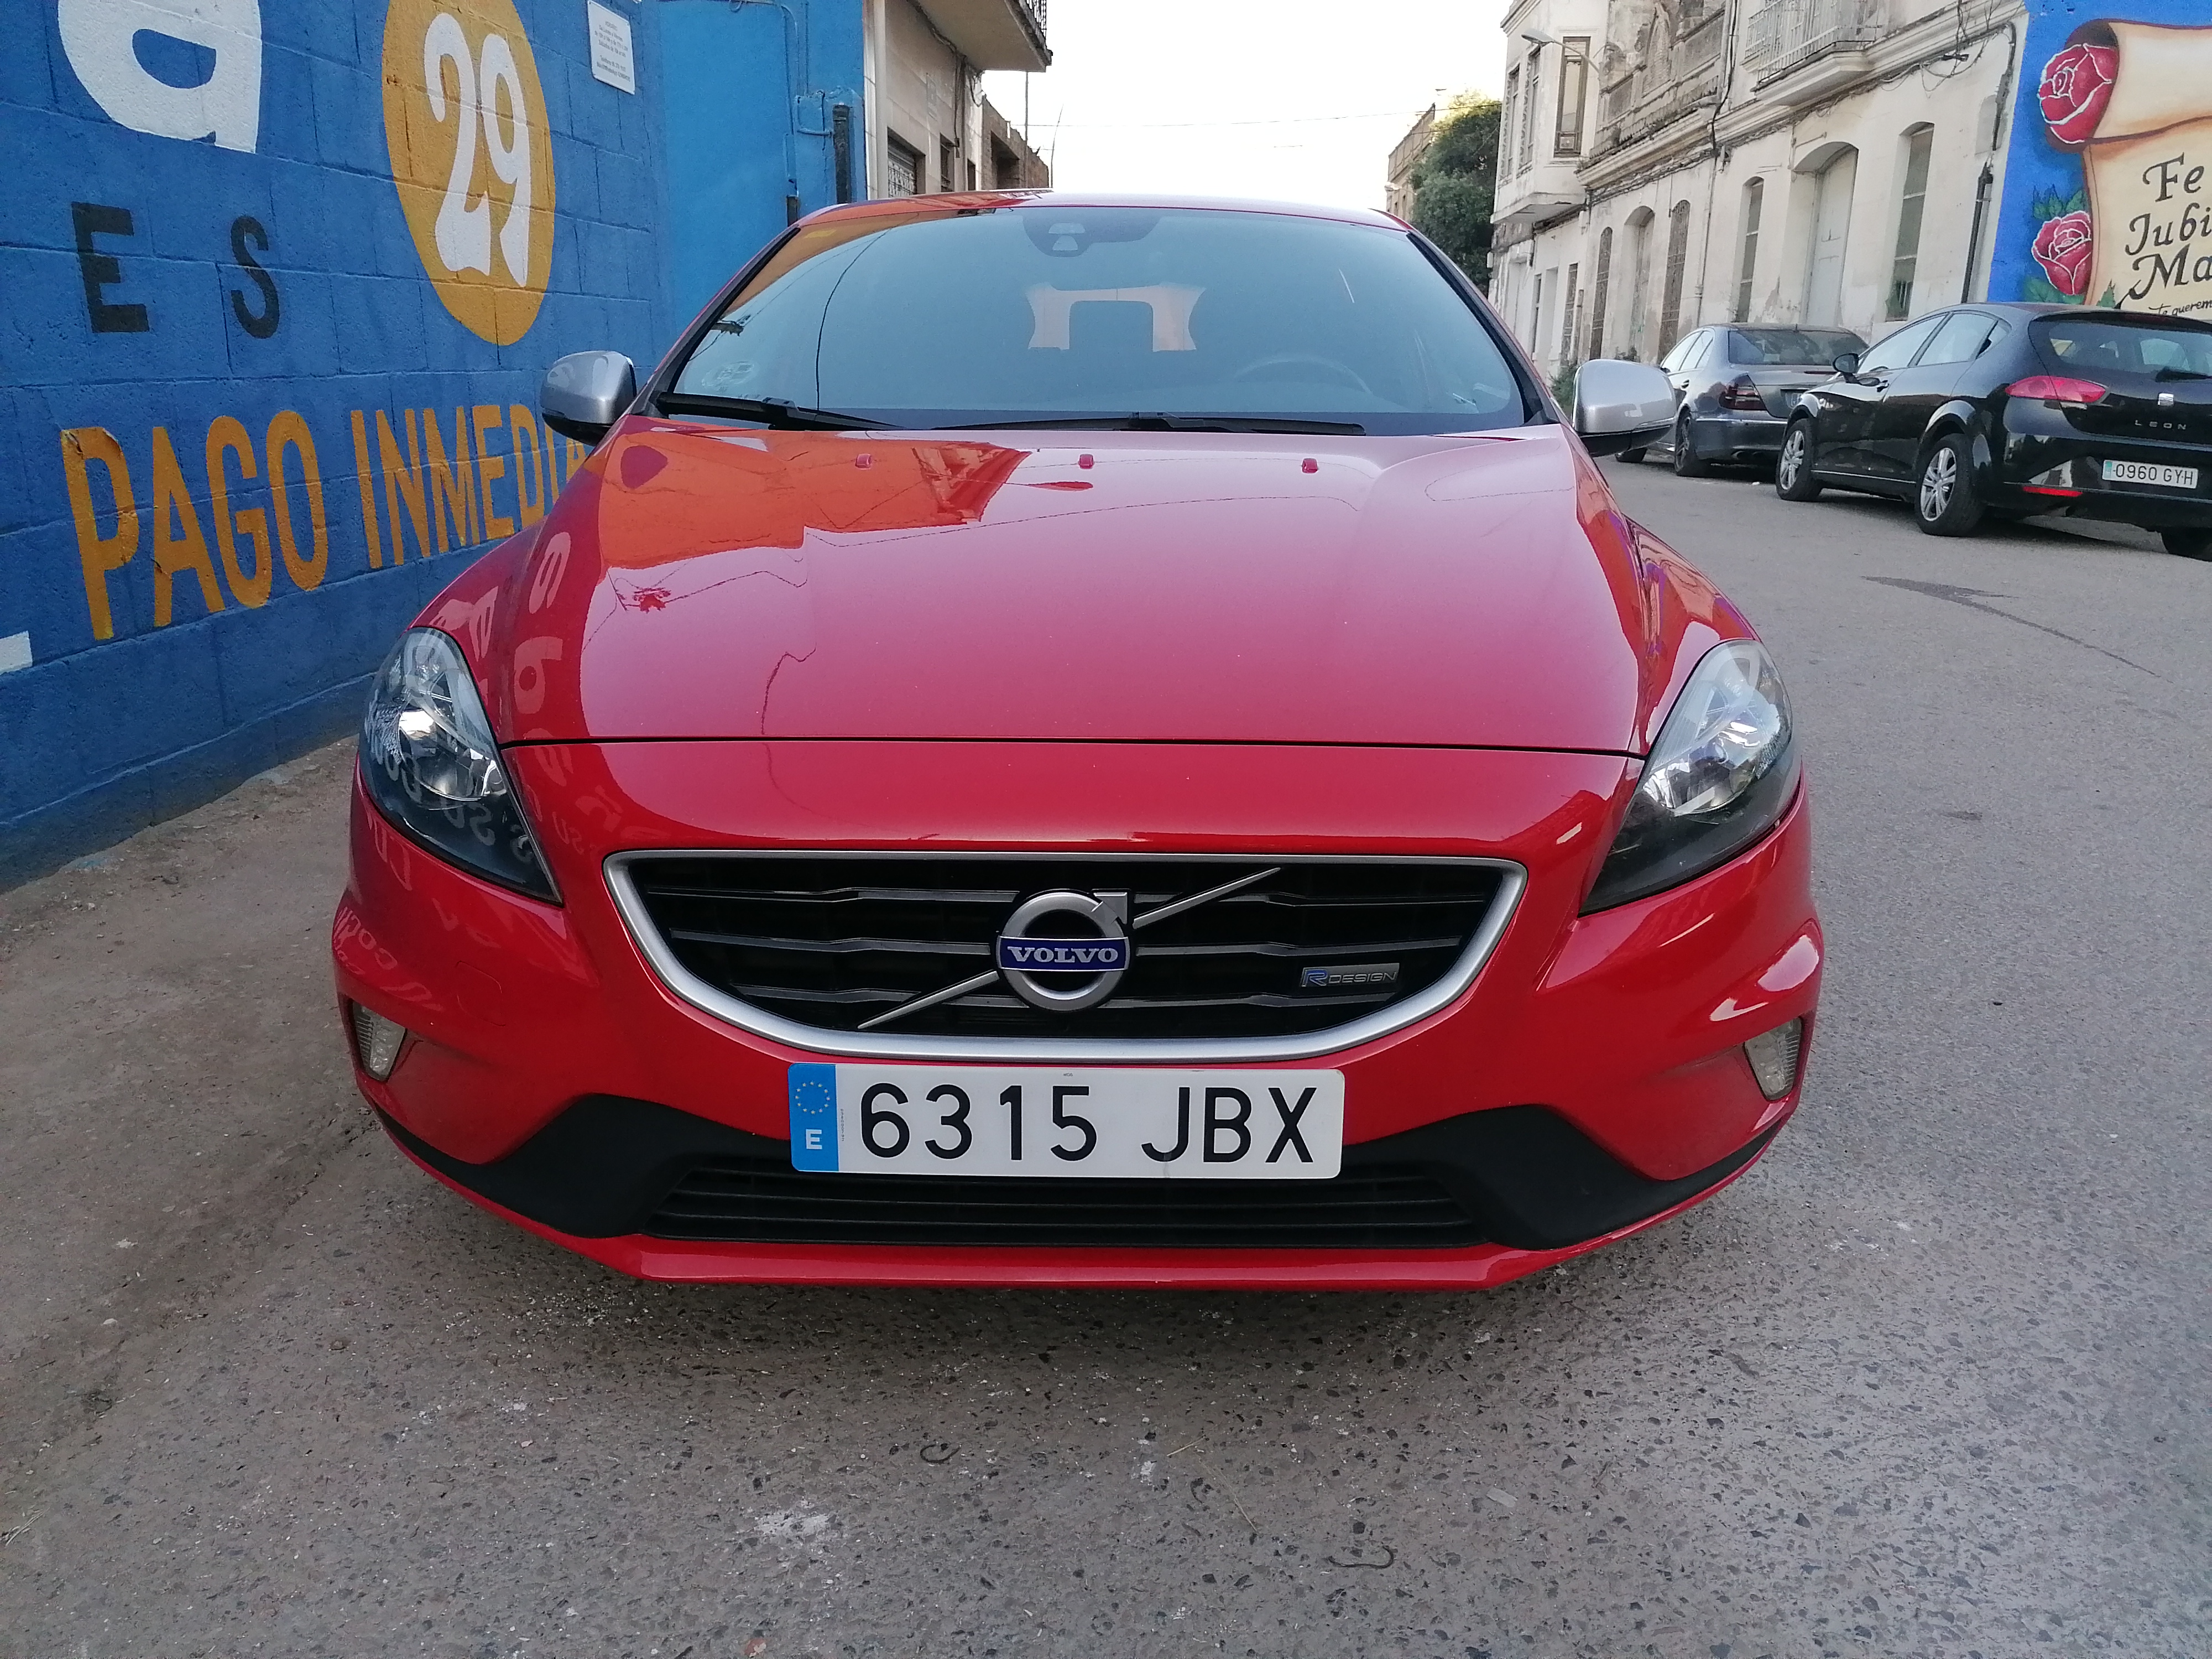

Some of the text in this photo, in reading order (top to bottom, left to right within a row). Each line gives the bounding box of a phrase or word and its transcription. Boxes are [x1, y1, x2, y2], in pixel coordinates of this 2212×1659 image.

[425, 12, 531, 287] 29
[2142, 152, 2205, 202] Fe
[2125, 202, 2212, 255] Jubi
[2135, 420, 2187, 430] LEON
[2116, 463, 2193, 485] 0960 GYH
[60, 410, 328, 640] PAGO
[1007, 946, 1118, 963] VOLVO
[806, 1129, 822, 1149] E
[860, 1082, 1097, 1161] 6315
[1141, 1087, 1317, 1163] JBX
